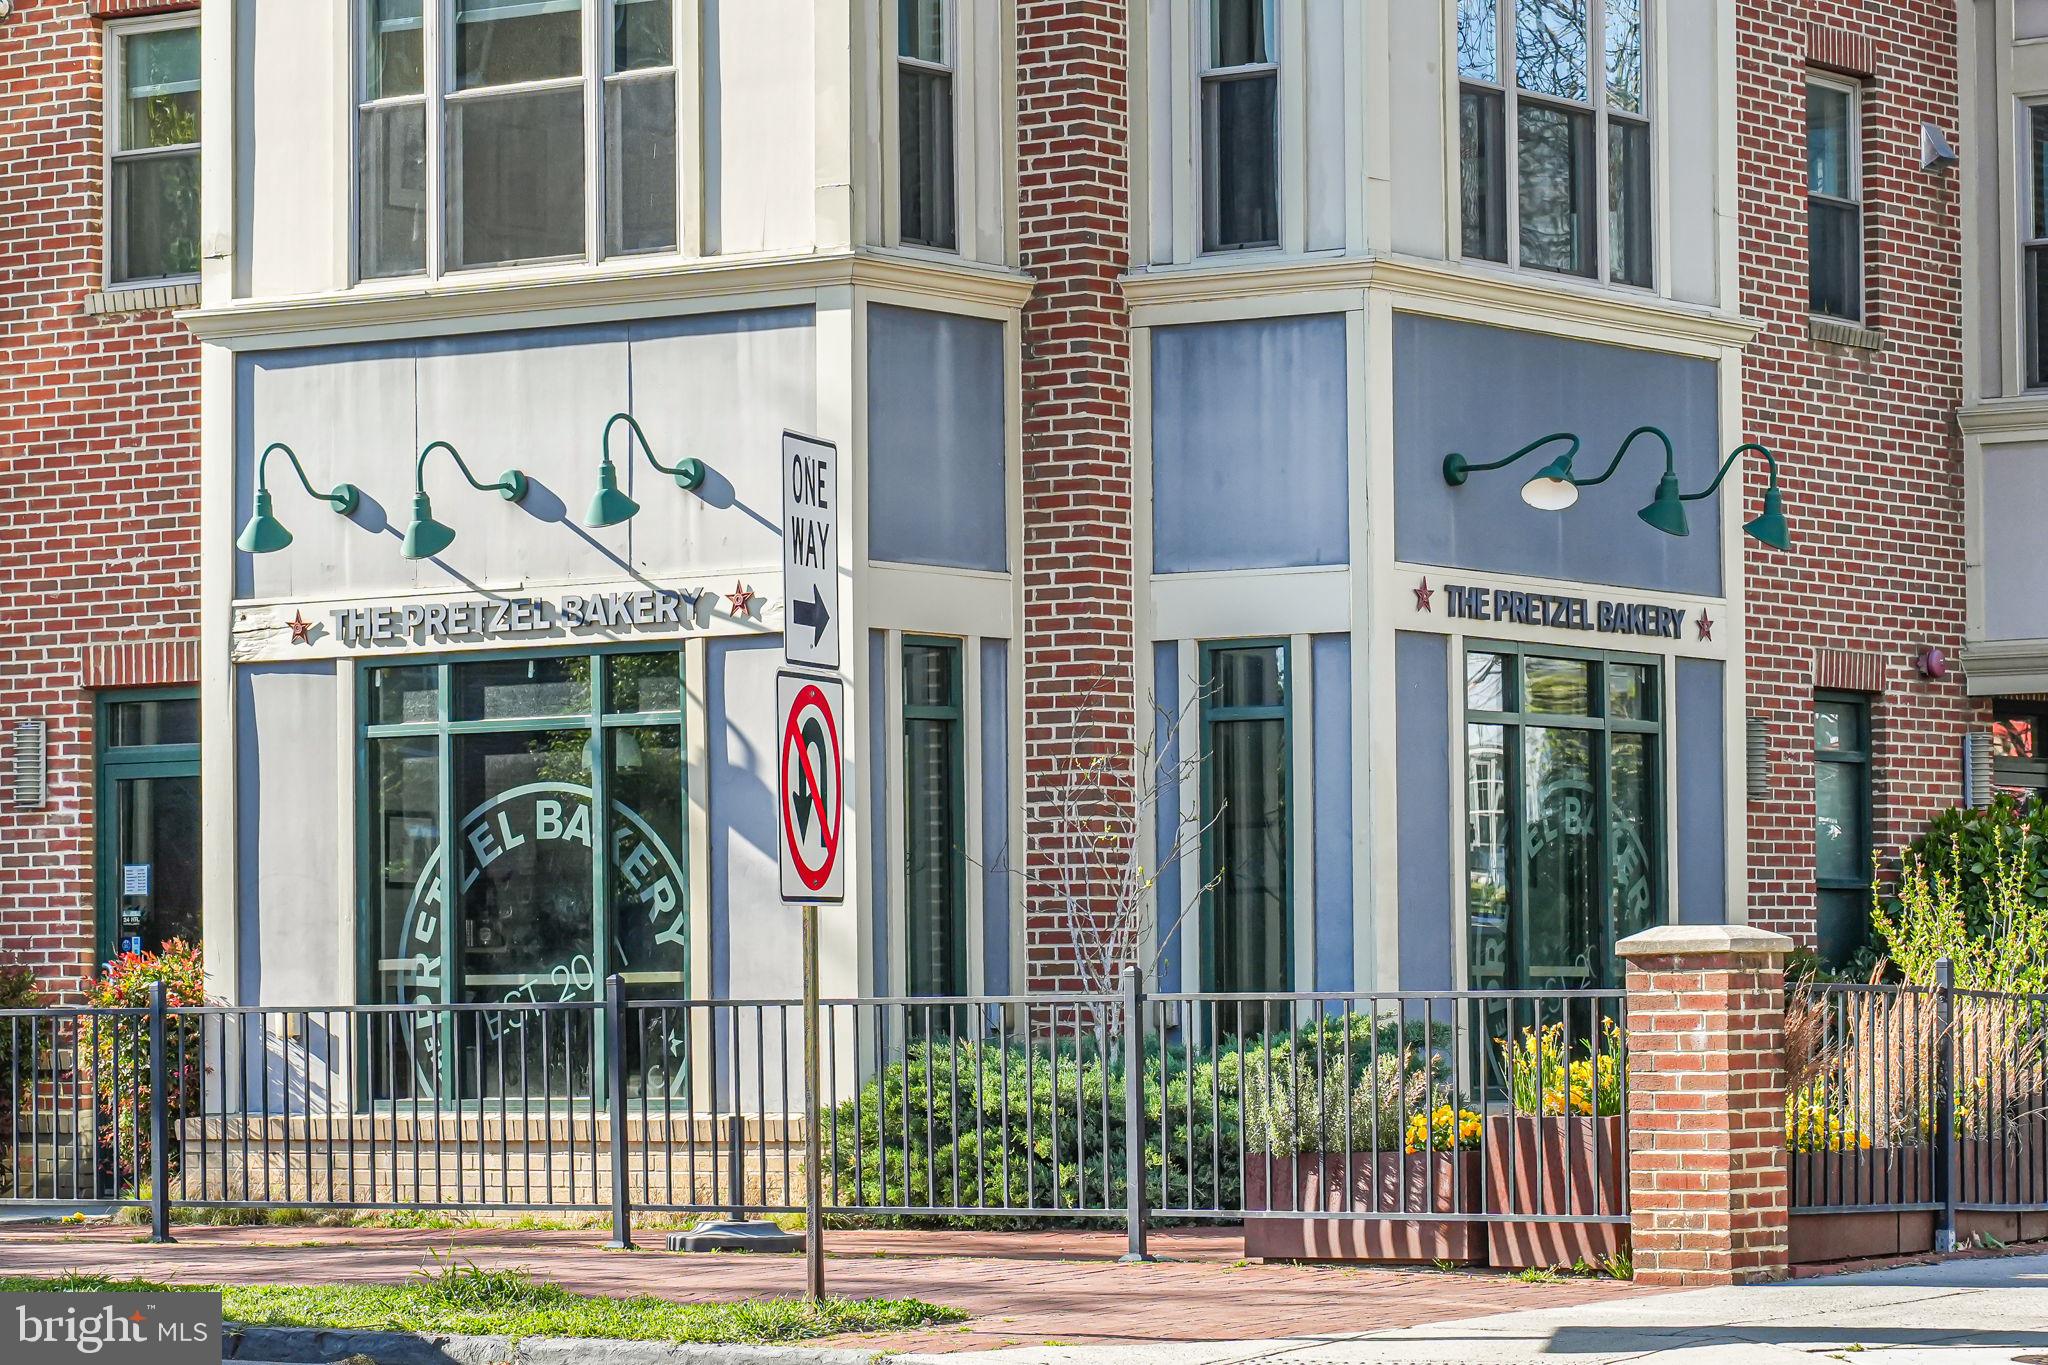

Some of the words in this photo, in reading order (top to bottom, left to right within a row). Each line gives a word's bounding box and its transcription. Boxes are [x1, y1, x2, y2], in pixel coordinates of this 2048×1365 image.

[792, 453, 828, 509] ONE
[791, 515, 830, 570] WAY
[329, 606, 396, 642] THE
[402, 597, 552, 638] PRETZEL
[560, 587, 704, 628] BAKERY
[1444, 585, 1490, 620] THE
[1494, 589, 1594, 630] PRETZEL
[1598, 600, 1686, 639] BAKERY
